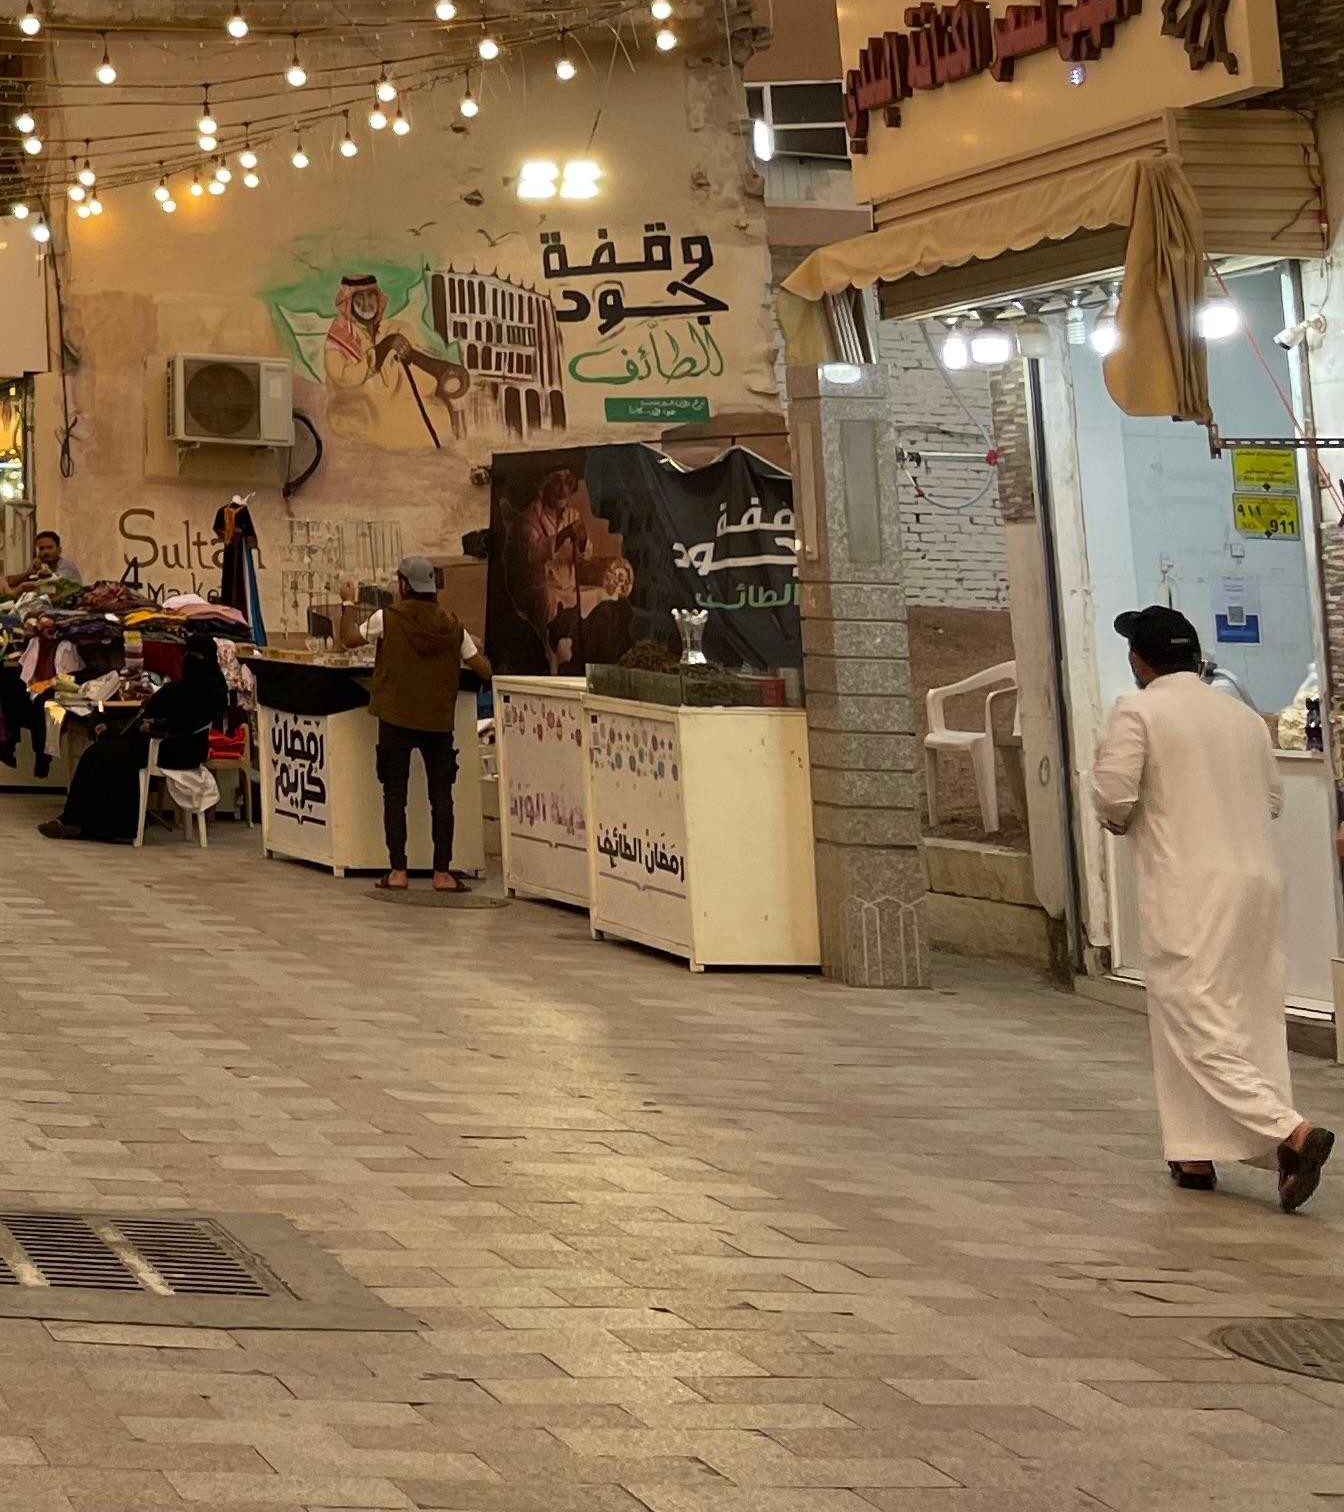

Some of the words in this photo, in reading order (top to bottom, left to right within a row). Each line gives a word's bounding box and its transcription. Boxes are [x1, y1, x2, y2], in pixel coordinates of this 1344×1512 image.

[539, 221, 714, 286] وقفة
[555, 280, 730, 335] جود
[568, 320, 725, 386] الطائف
[715, 496, 796, 538] قفة
[1236, 503, 1262, 520] ٩١١
[1269, 518, 1295, 534] 911
